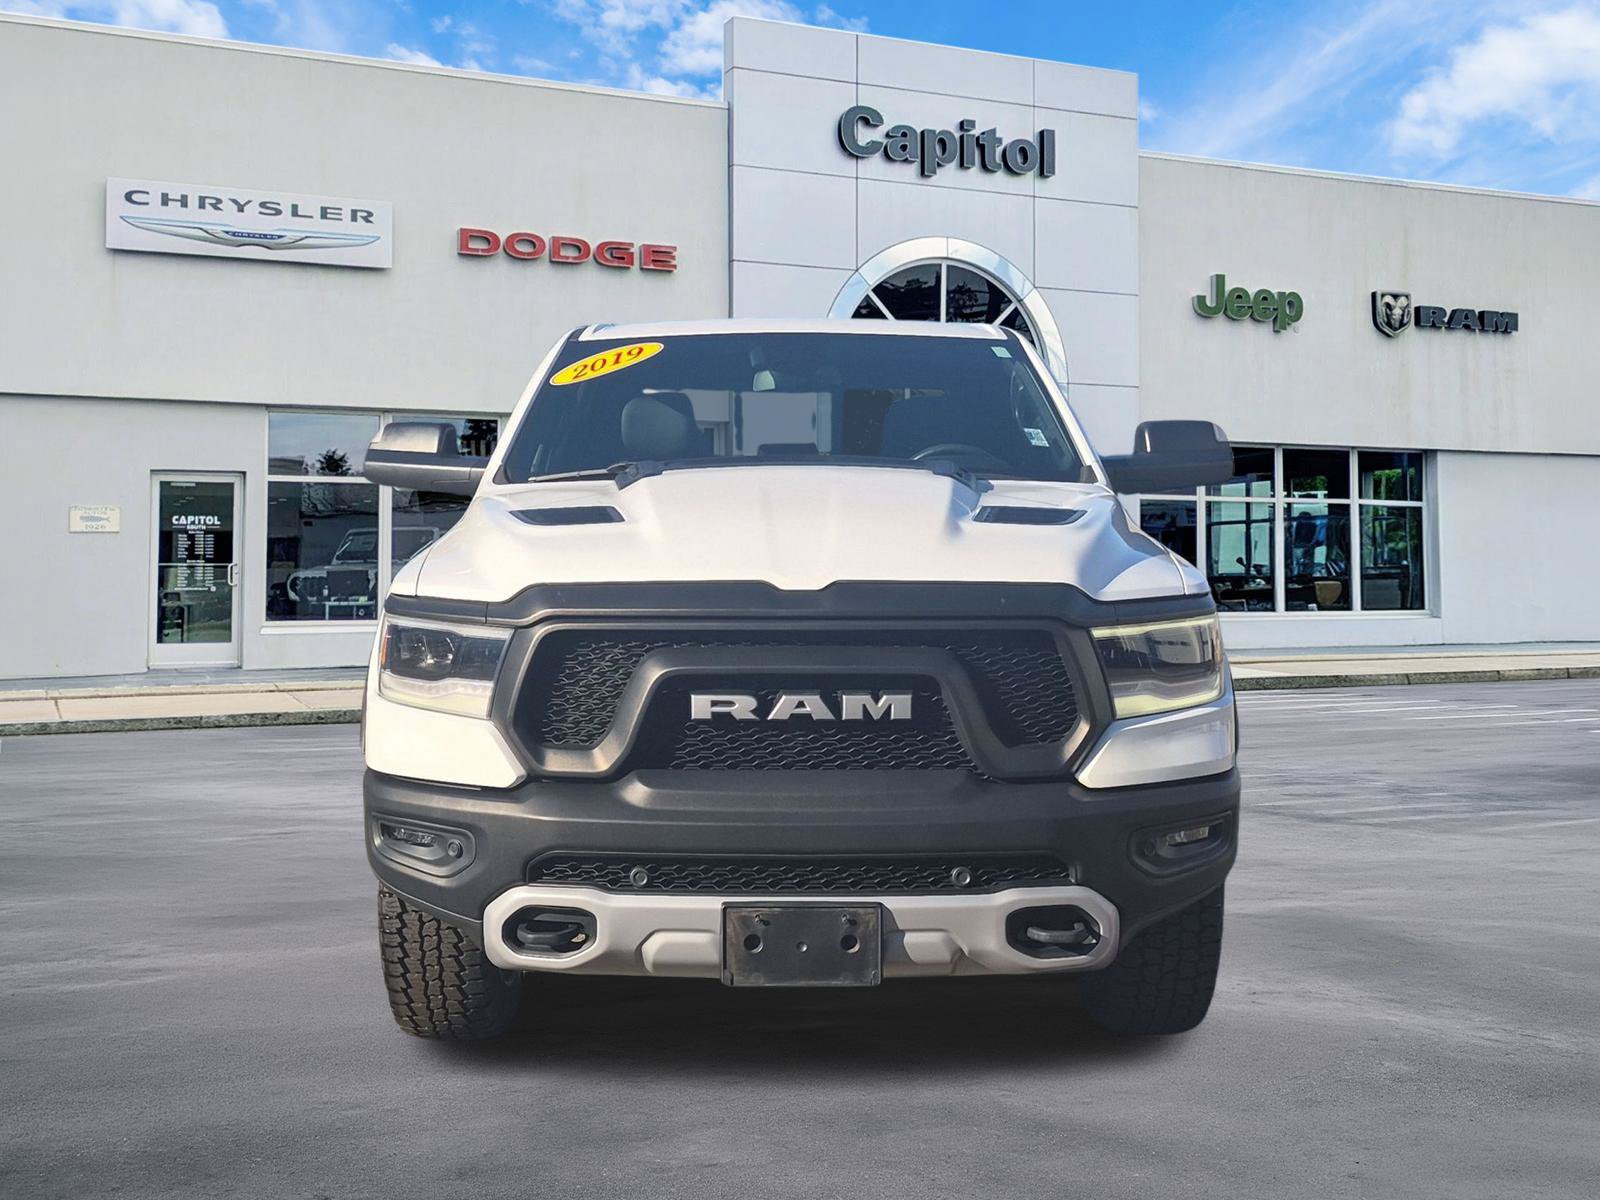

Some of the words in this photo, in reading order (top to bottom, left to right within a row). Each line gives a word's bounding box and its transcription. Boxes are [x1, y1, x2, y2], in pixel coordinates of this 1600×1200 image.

[838, 105, 1056, 177] Capitol
[123, 189, 375, 224] CHRYSLER
[457, 227, 678, 272] DODGE
[1192, 274, 1303, 333] Jeep
[1414, 305, 1519, 333] RAM
[572, 346, 644, 381] 2019
[172, 515, 221, 525] CAPITOL
[690, 691, 913, 720] RAM
